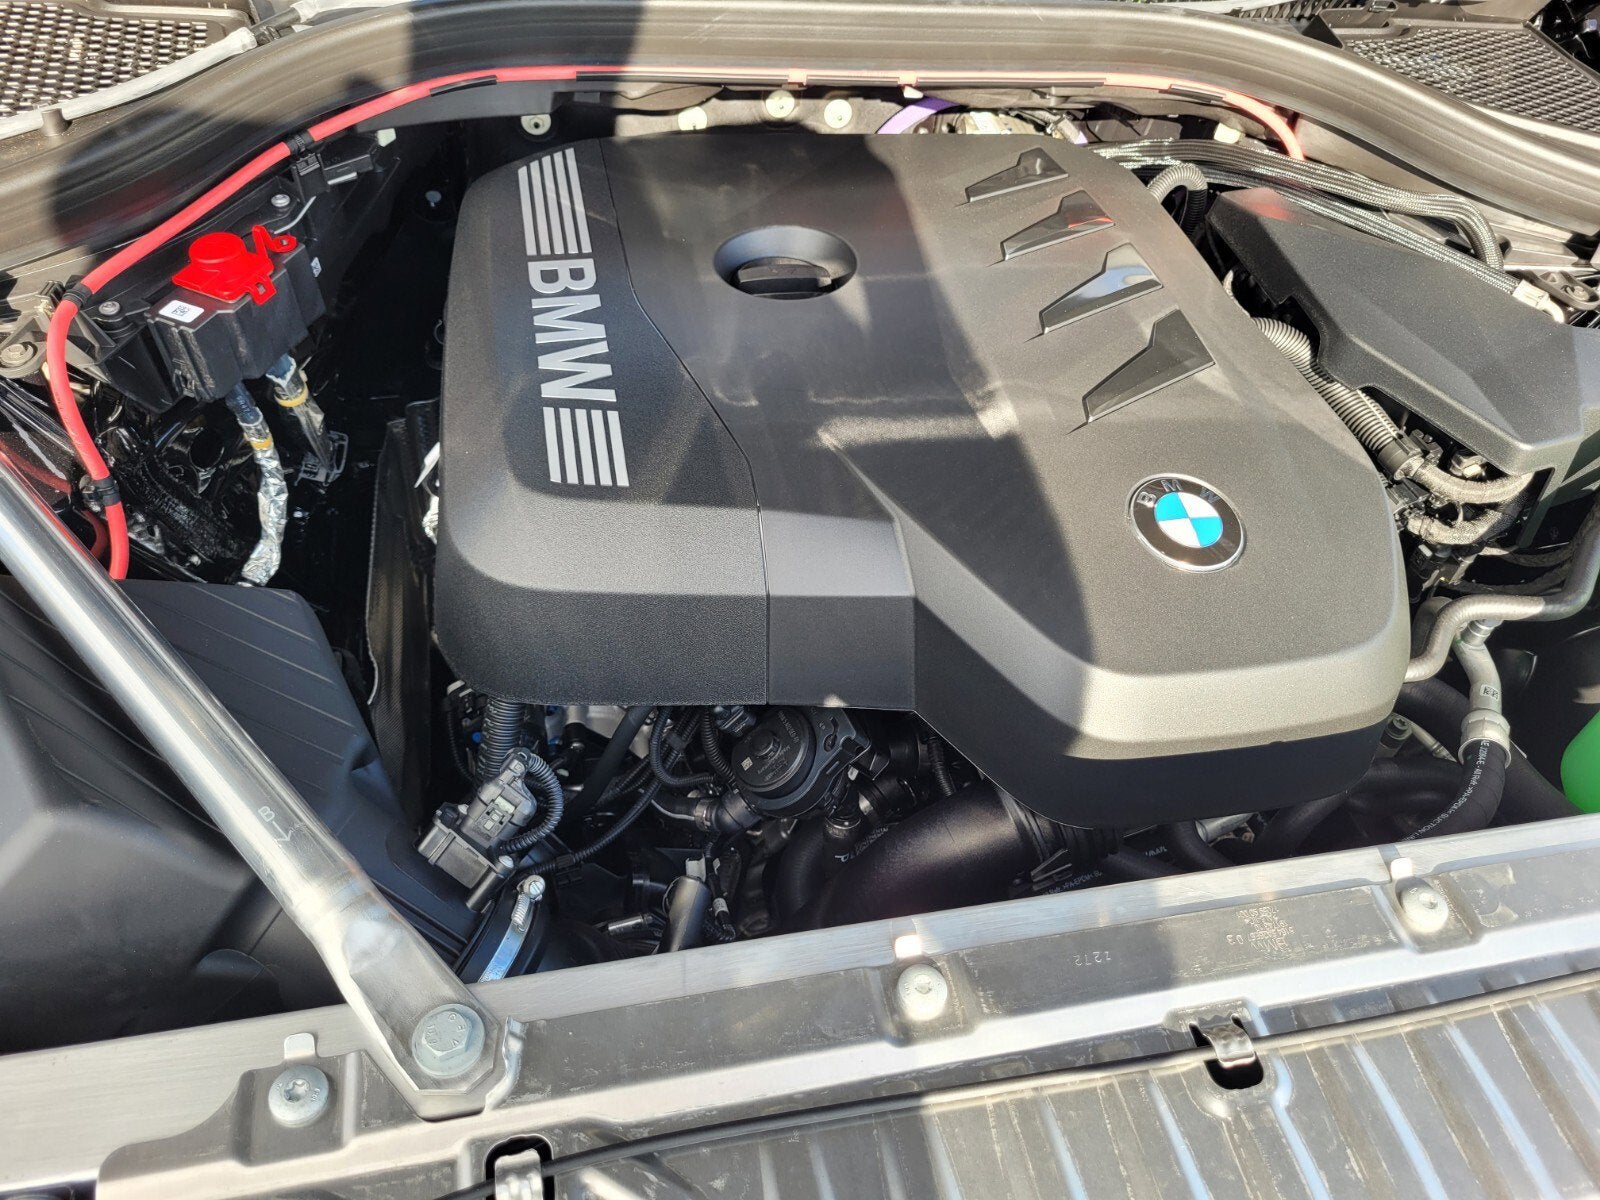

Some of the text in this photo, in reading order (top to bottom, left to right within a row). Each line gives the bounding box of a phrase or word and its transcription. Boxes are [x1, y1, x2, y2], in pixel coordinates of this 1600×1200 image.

[527, 258, 617, 402] BMW
[1136, 479, 1220, 508] BMW
[258, 805, 275, 822] B
